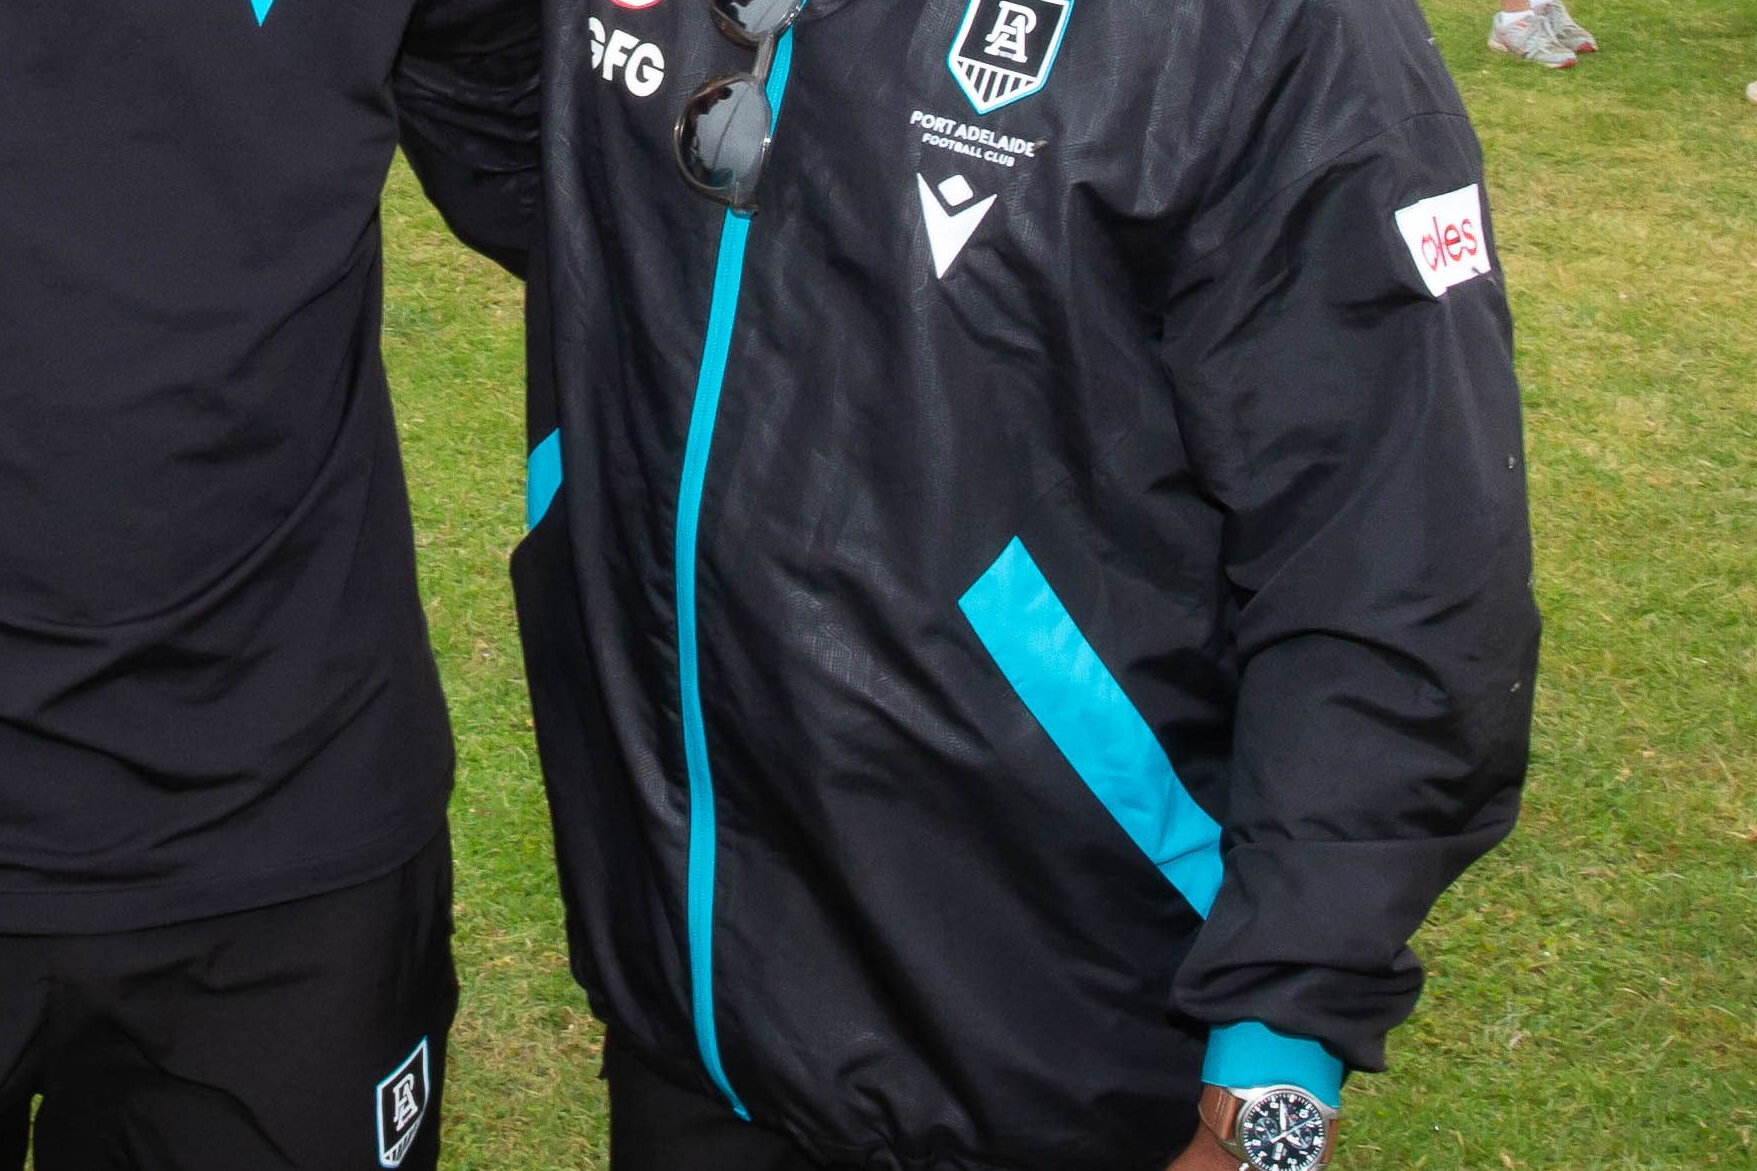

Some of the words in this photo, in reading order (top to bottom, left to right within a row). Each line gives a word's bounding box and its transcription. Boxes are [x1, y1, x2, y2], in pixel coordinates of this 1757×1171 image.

[909, 110, 957, 135] PORT
[953, 124, 1036, 158] ADELAIDE
[922, 132, 983, 159] FOOTBALL
[984, 150, 1015, 167] CLUB
